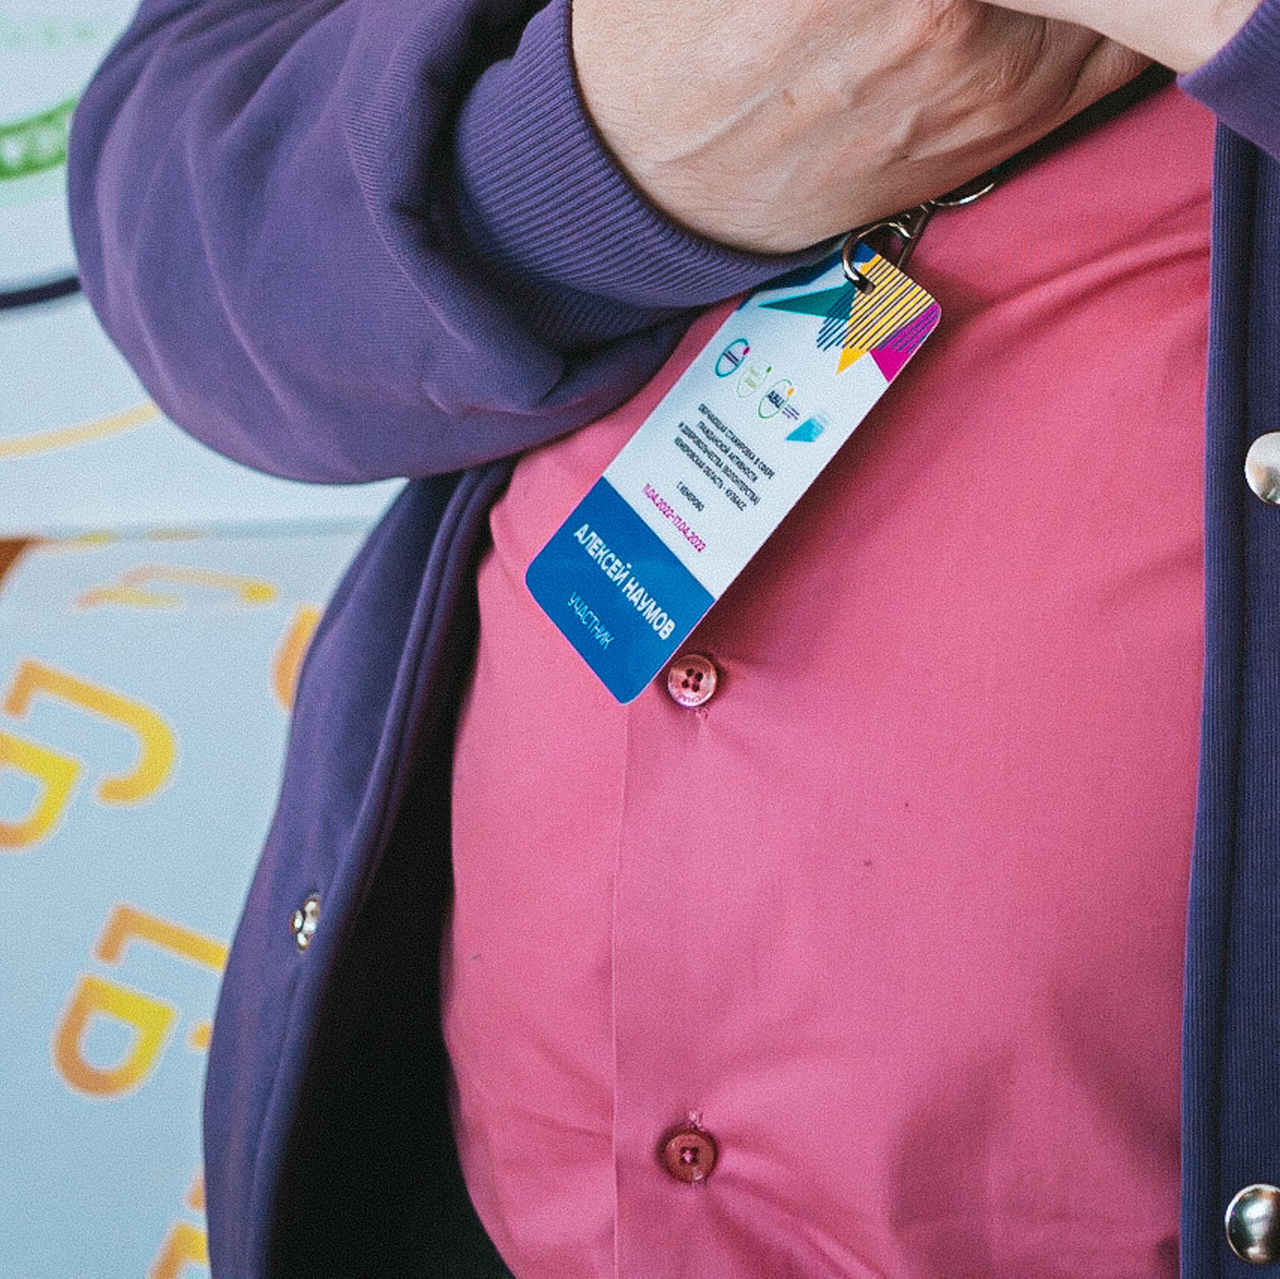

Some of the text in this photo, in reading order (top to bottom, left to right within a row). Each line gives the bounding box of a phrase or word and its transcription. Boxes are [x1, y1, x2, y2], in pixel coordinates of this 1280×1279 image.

[674, 436, 706, 469] КЕМЕРОВСКАЯ
[703, 465, 725, 489] ОБЛАСТЬ
[725, 488, 747, 511] КУЗБАСС
[680, 424, 724, 468] ДОБРОВОЛЬЧЕСТВА
[697, 420, 758, 482] ГРАЖДАНСКОЙ АКТИВНОСТИ
[726, 429, 756, 461] СТАЖИРОВКА
[757, 461, 775, 480] СФЕРЕ
[680, 484, 705, 512] КЕМЕРОВО
[573, 522, 676, 640] АЛЕКСЕЙ НАУМОВ
[566, 591, 615, 650] УЧАСТНИК
